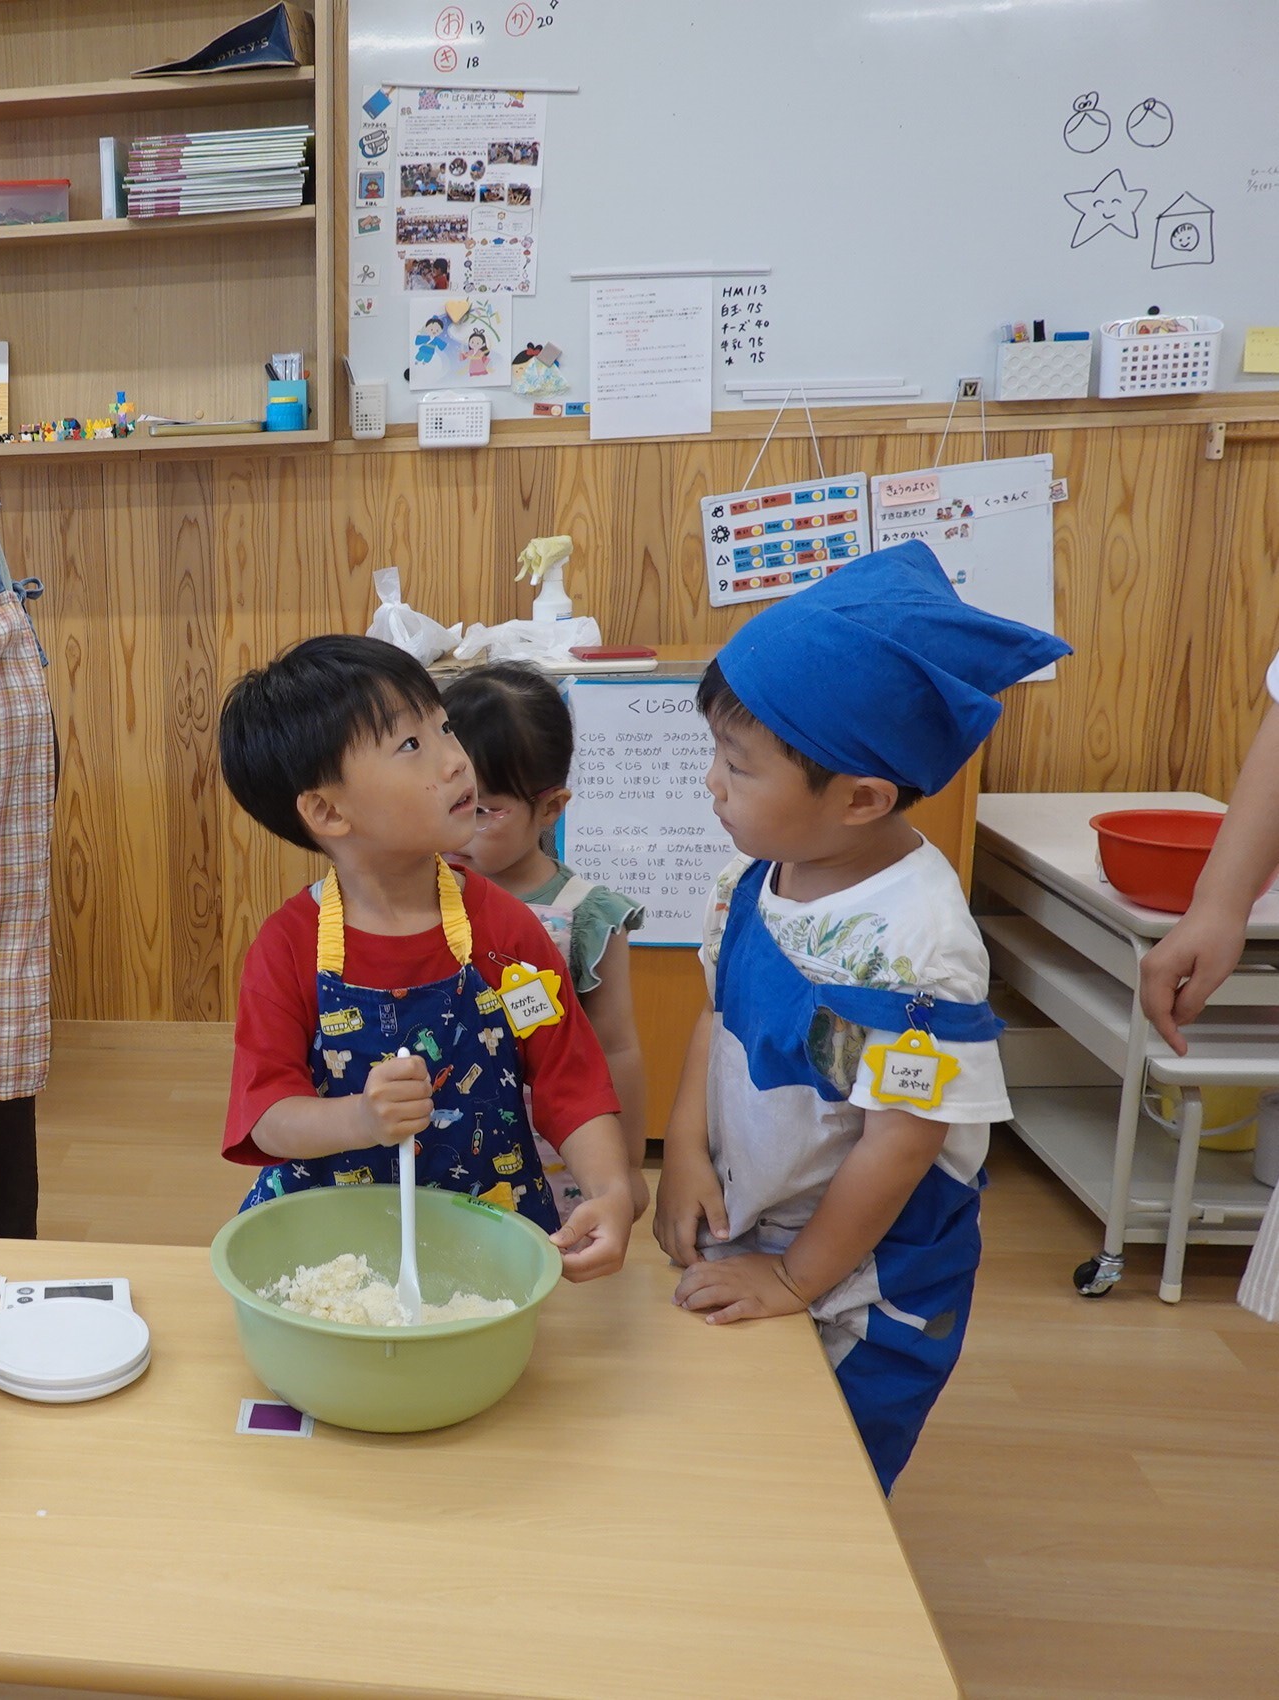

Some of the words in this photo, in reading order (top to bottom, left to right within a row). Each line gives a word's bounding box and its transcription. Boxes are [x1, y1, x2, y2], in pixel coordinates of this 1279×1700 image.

[470, 20, 485, 35] 13
[537, 15, 554, 29] 20
[466, 56, 480, 69] 18
[723, 286, 744, 297] HM
[747, 284, 767, 296] 113
[747, 303, 763, 314] 75
[722, 319, 750, 335] チーズ
[755, 319, 770, 329] 40
[749, 336, 764, 348] 75
[750, 351, 765, 363] 75
[886, 481, 935, 497] きょうのよてい
[984, 490, 1029, 507] くっきんぐ
[881, 507, 926, 522] すきなあそび
[882, 529, 929, 542] あさのかい
[628, 698, 705, 714] くじらの
[579, 732, 606, 742] くじら
[662, 732, 709, 742] うみのうえ
[578, 747, 615, 757] とんでる
[624, 746, 662, 756] かもめが
[578, 761, 605, 771] くじら
[615, 761, 642, 771] くじら
[651, 761, 670, 771] いま
[679, 761, 708, 771] なんじ
[577, 789, 614, 799] くじらの
[618, 789, 655, 799] とけいは
[577, 826, 604, 836] くじら
[659, 826, 706, 836] うみのなか
[574, 843, 611, 853] かしこい
[667, 843, 731, 853] じかんをきいた
[575, 857, 602, 867] くじら
[611, 857, 638, 867] くじら
[647, 857, 666, 867] いま
[674, 857, 703, 867] なんじ
[645, 909, 692, 918] いまなんじ
[510, 995, 536, 1010] なかた
[523, 1002, 549, 1018] ひなた
[891, 1065, 922, 1078] しみず
[898, 1078, 930, 1092] あやせ
